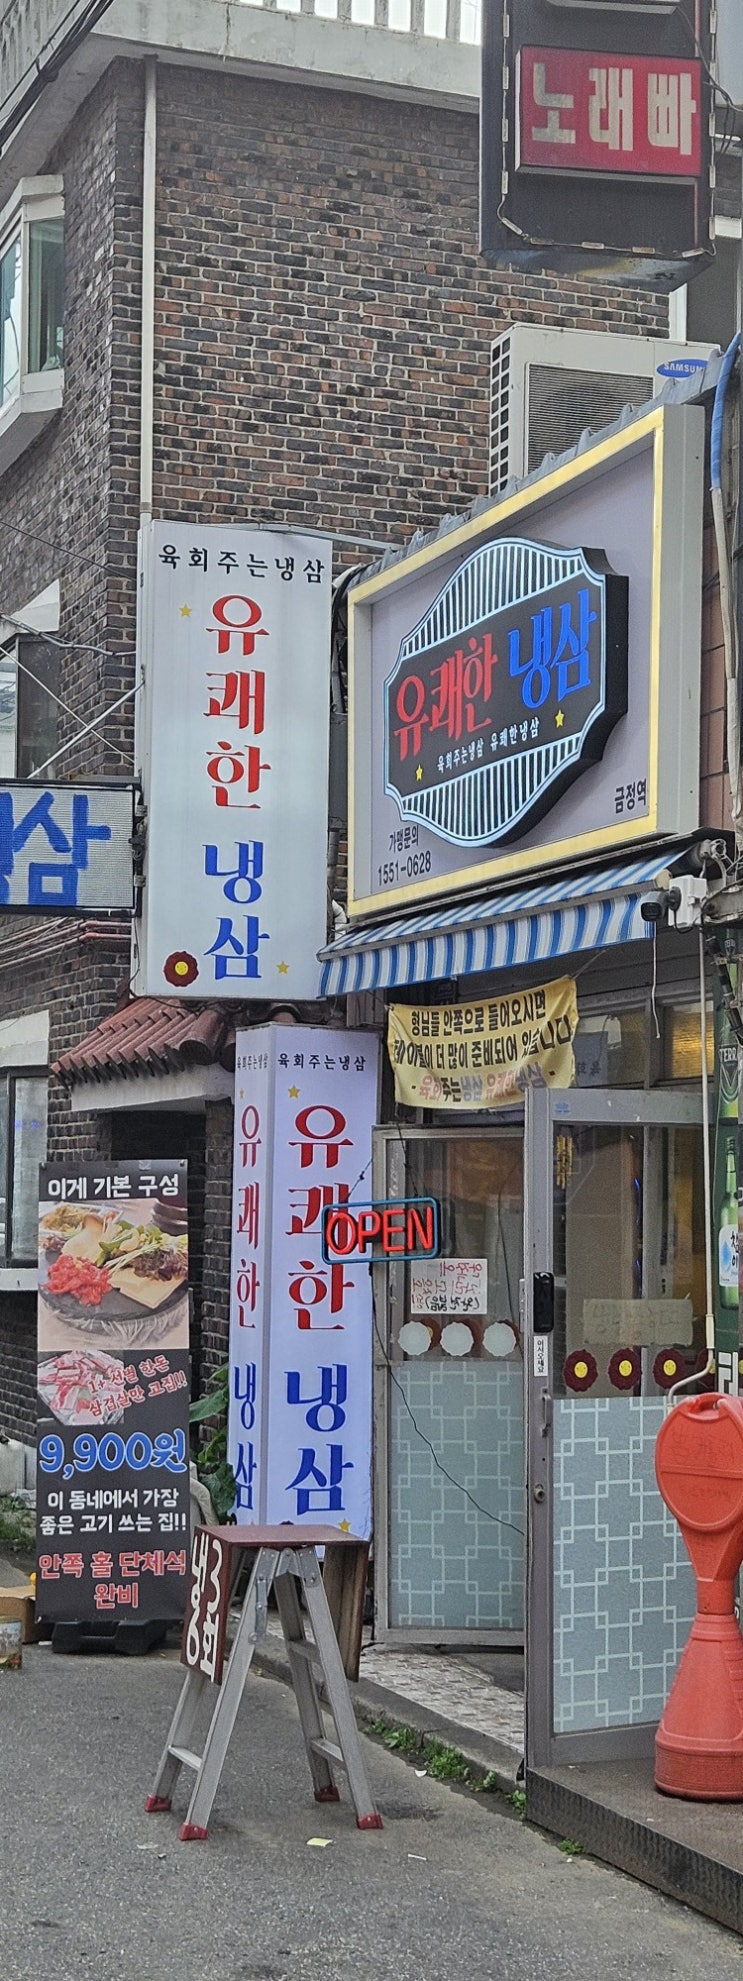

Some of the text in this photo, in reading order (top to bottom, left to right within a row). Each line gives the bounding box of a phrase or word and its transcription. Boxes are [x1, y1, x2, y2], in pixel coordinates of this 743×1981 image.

[532, 61, 697, 156] 노래빠
[664, 362, 705, 374] SAMSU
[159, 543, 325, 584] 육회주는냉삼
[393, 588, 598, 762] 유쾌한 냉삼
[436, 716, 540, 774] 육회주는냉삼 유쾌한냉삼
[202, 594, 271, 981] 유쾌한 냉삼
[613, 778, 648, 814] 금정역
[388, 824, 419, 853] 가맹문의
[377, 850, 432, 886] 1551-0628
[411, 989, 547, 1037] 형님들 안쪽으로 들어오시면
[277, 1053, 367, 1072] 육회주는냉삼
[436, 1045, 445, 1070] 더
[448, 1041, 468, 1070] 많이
[471, 1033, 518, 1068] 준비되어
[521, 1014, 573, 1059] 있습니다
[47, 1173, 179, 1200] 이게 기본 구성
[326, 1206, 433, 1255] OPEN
[234, 1104, 262, 1511] 유쾌한 냉삼
[283, 1104, 355, 1516] 유쾌한 냉삼
[88, 1354, 170, 1394] 1+ 선별 한돈
[89, 1370, 188, 1417] 삼겹살만 고집!!!
[39, 1427, 187, 1480] 9,900원
[47, 1487, 179, 1510] 이 동네에서 가장
[40, 1512, 187, 1535] 좋은 고기 쓰는 집!!
[38, 1549, 187, 1580] 안쪽 홀 단체석
[93, 1582, 139, 1609] 완비
